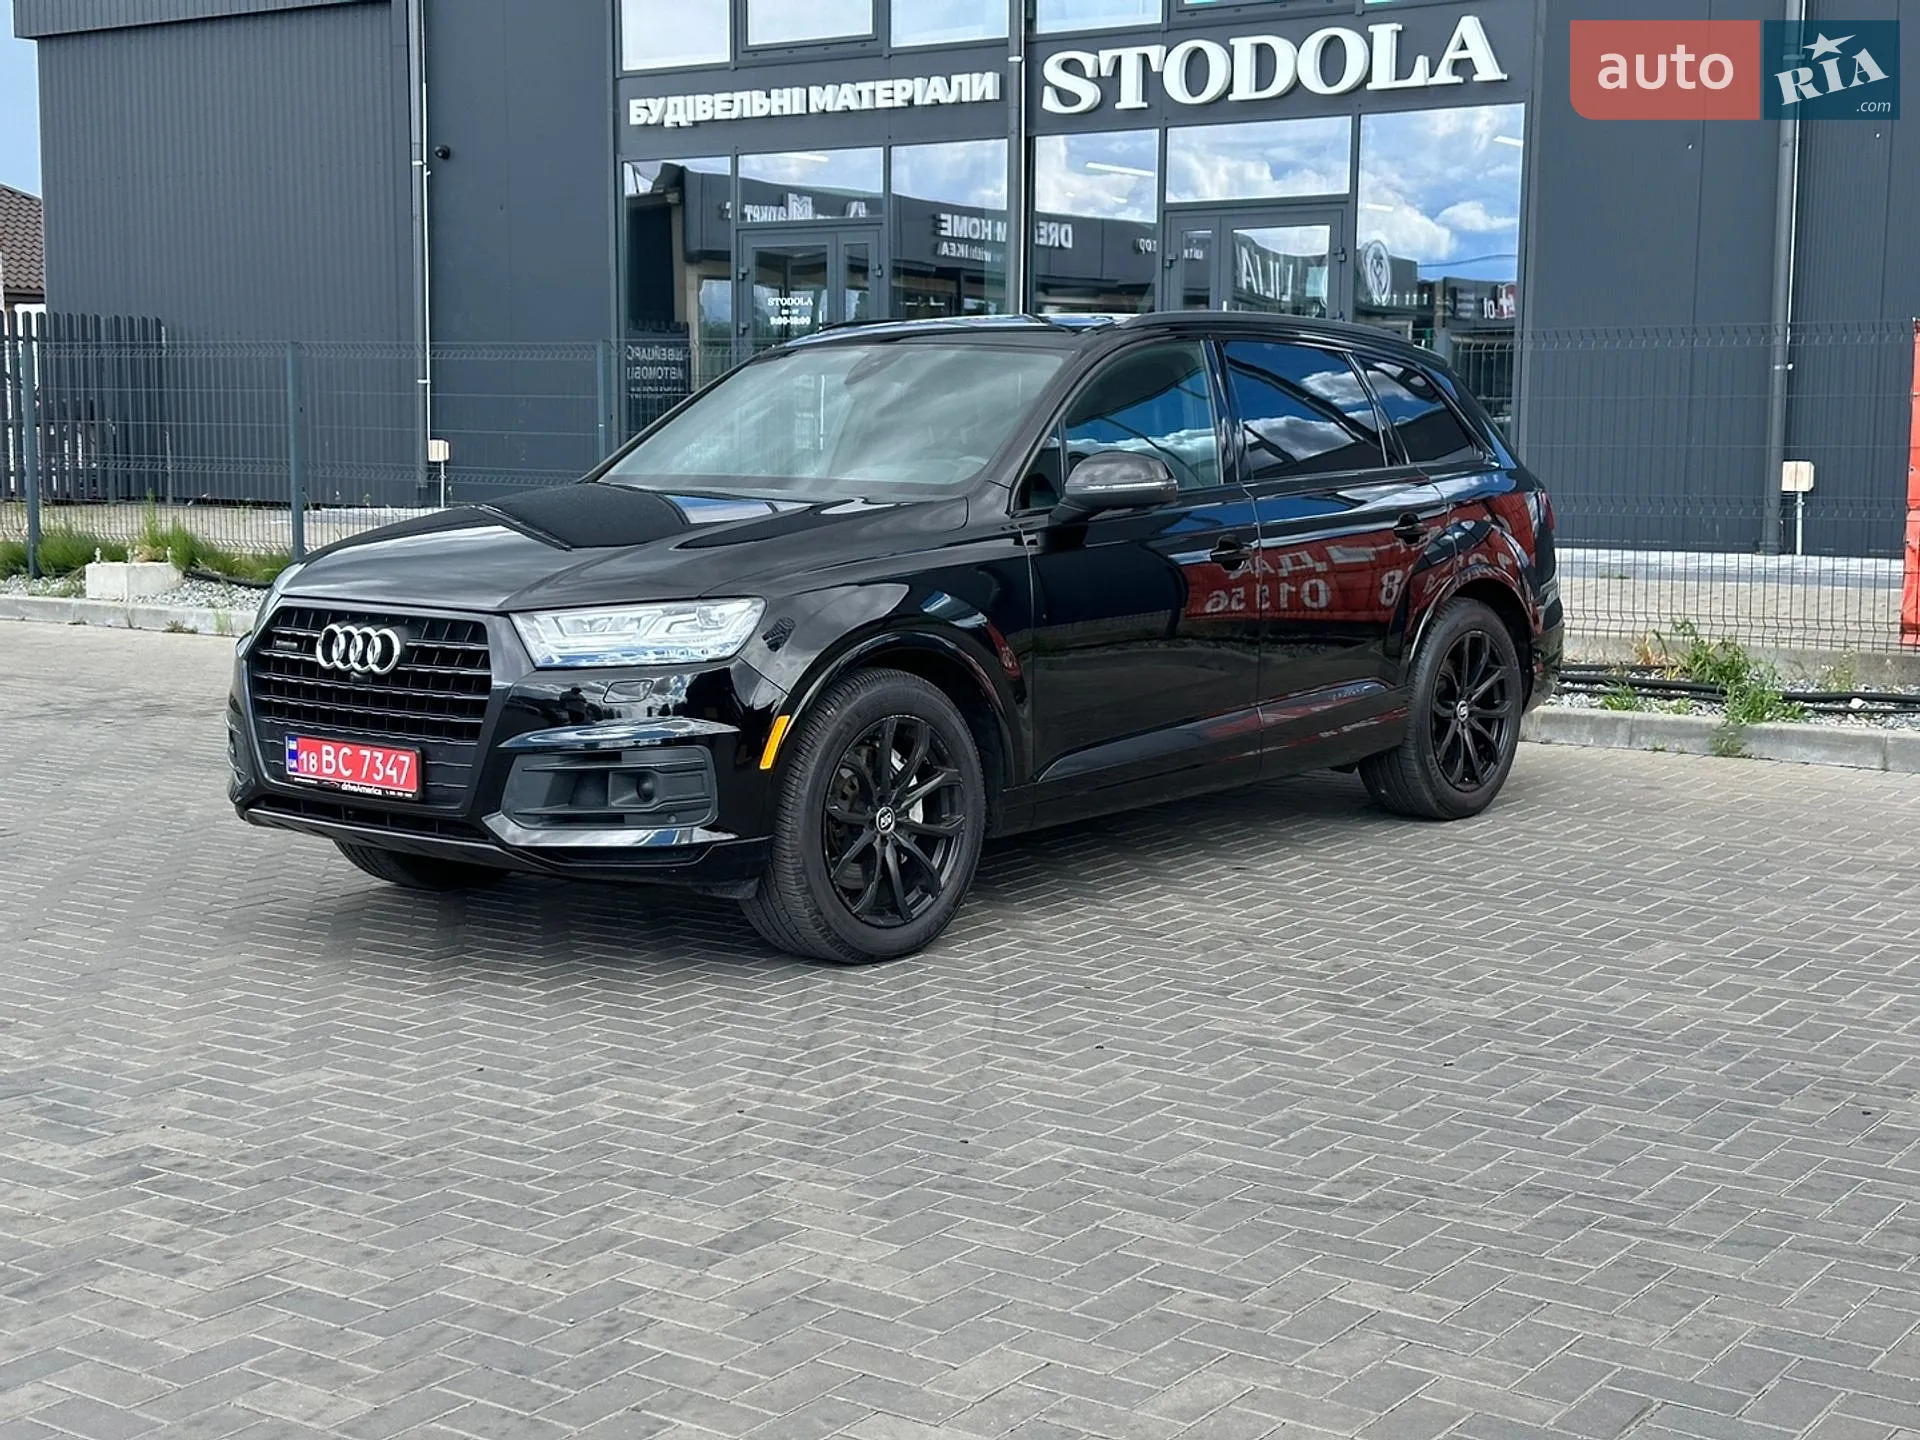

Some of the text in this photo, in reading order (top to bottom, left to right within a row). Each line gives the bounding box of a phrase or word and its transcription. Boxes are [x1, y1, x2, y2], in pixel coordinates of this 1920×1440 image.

[1042, 15, 1508, 114] STODOLA
[629, 72, 1000, 128] БУДІВЕЛЬНІ МАТЕРІАЛИ
[767, 297, 813, 307] STODOLA
[321, 744, 353, 778] BC
[359, 749, 411, 786] 7347
